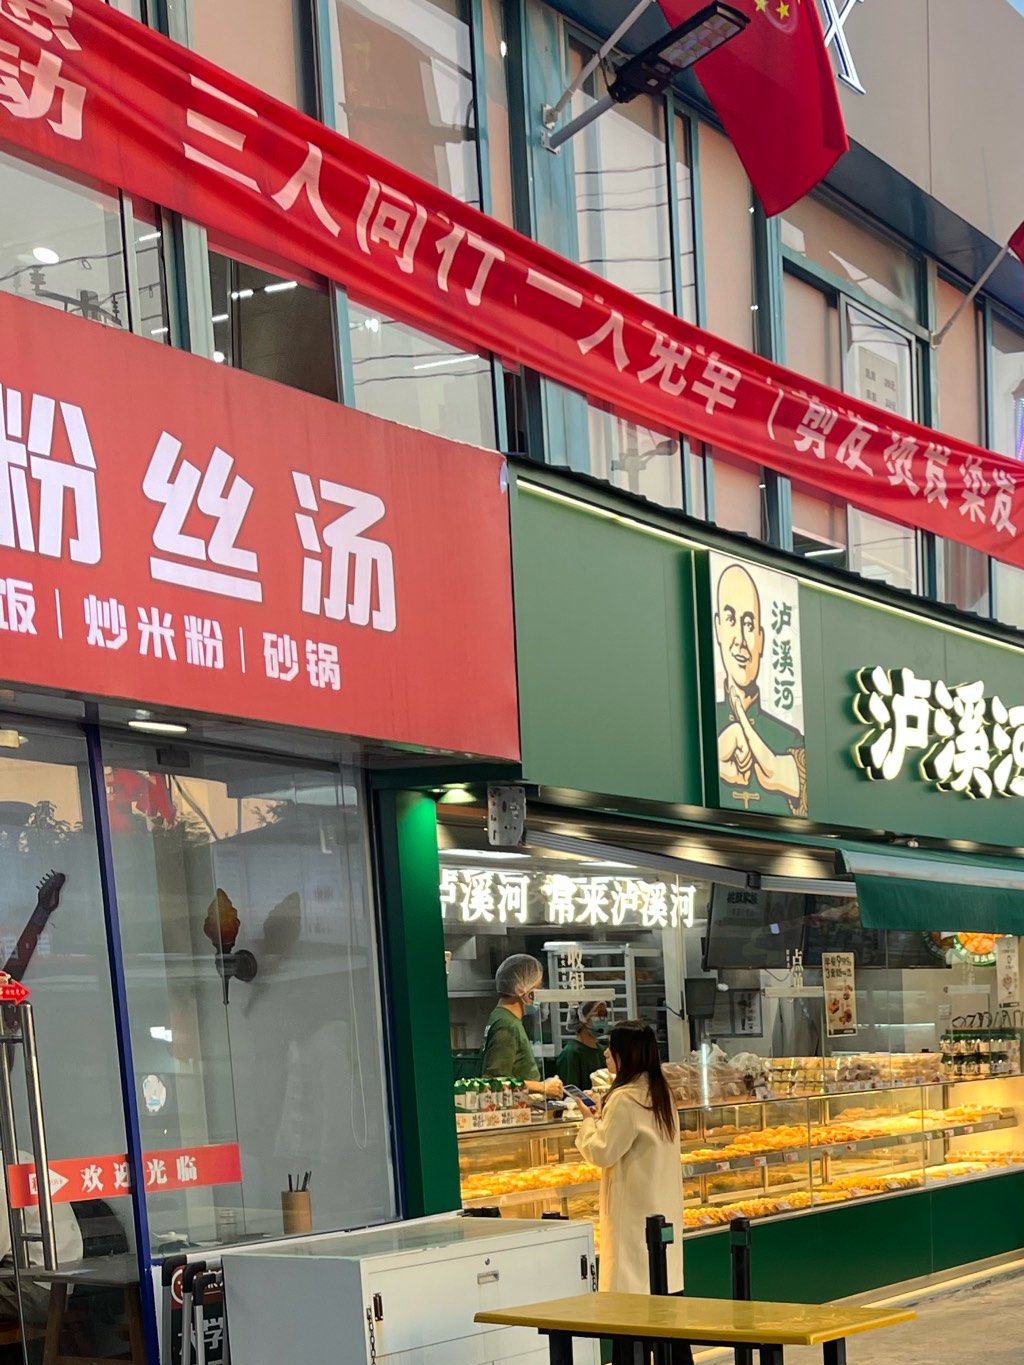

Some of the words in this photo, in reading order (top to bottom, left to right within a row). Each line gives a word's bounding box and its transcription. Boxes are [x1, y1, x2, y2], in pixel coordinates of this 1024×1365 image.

[0, 383, 397, 633] 粉丝汤
[83, 593, 225, 670] 炒米粉
[262, 630, 342, 692] 砂锅
[771, 600, 795, 711] 泸溪河
[80, 1155, 199, 1194] 欢迎光临
